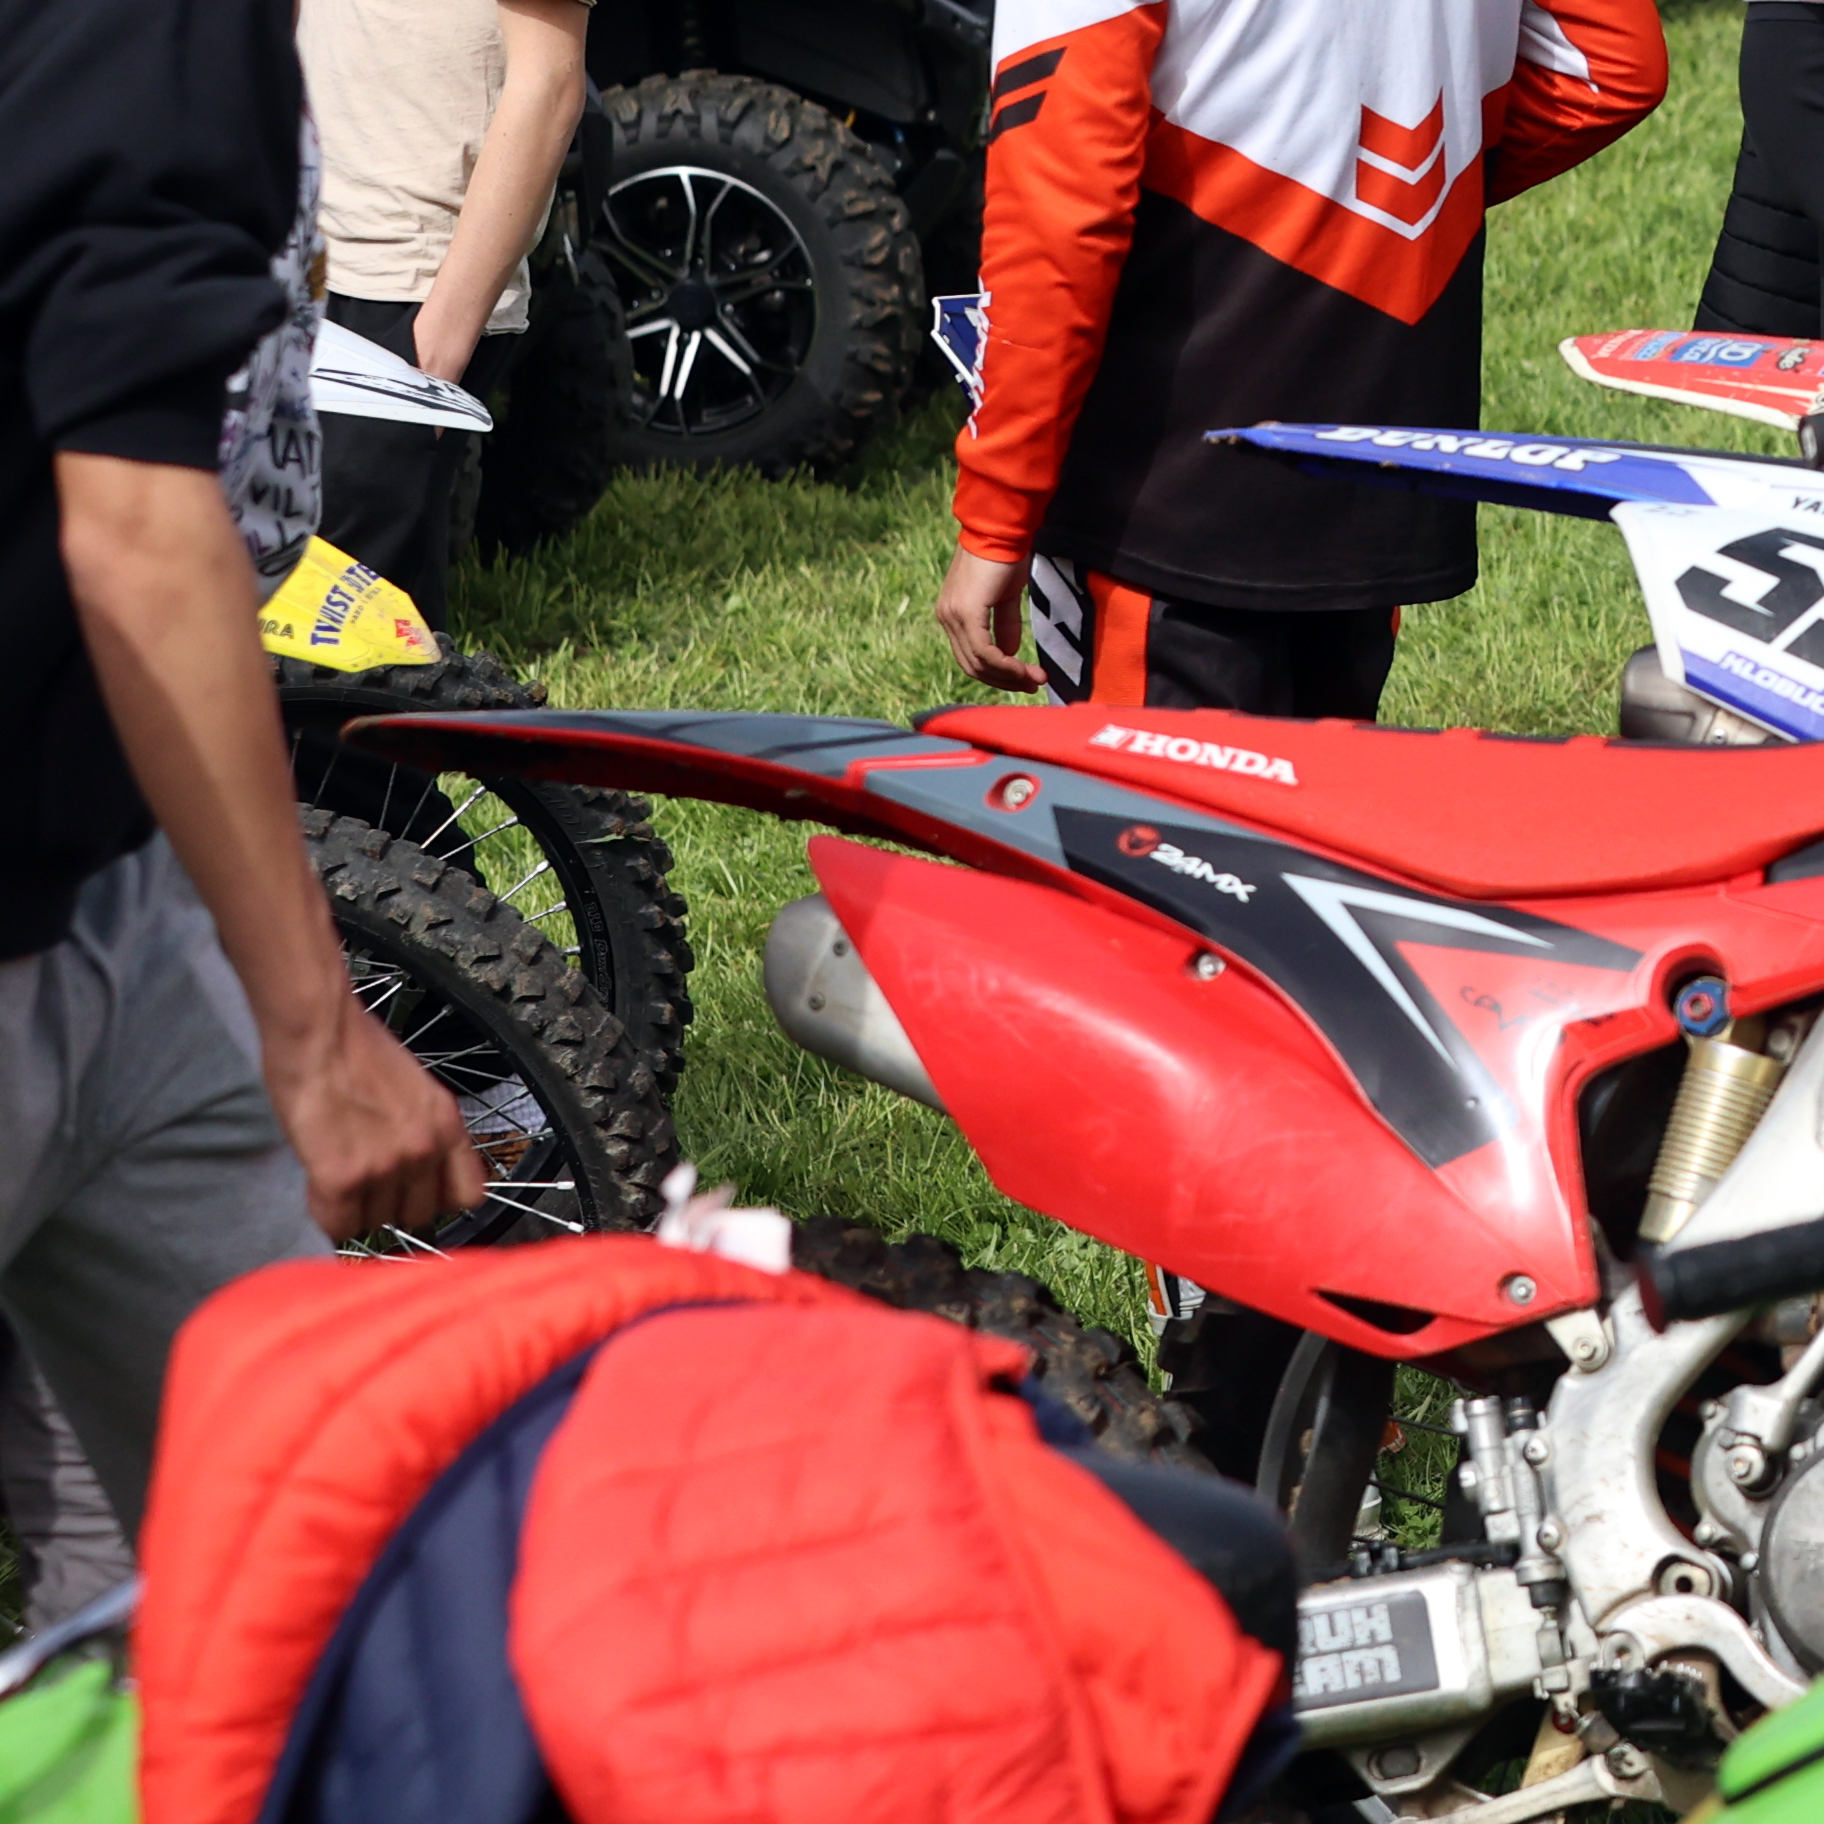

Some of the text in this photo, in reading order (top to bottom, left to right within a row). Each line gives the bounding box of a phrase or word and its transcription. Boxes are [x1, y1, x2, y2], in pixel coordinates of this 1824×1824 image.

[1314, 424, 1625, 472] DUNLOP
[1127, 728, 1299, 786] HONDA
[1149, 842, 1258, 904] 24MX
